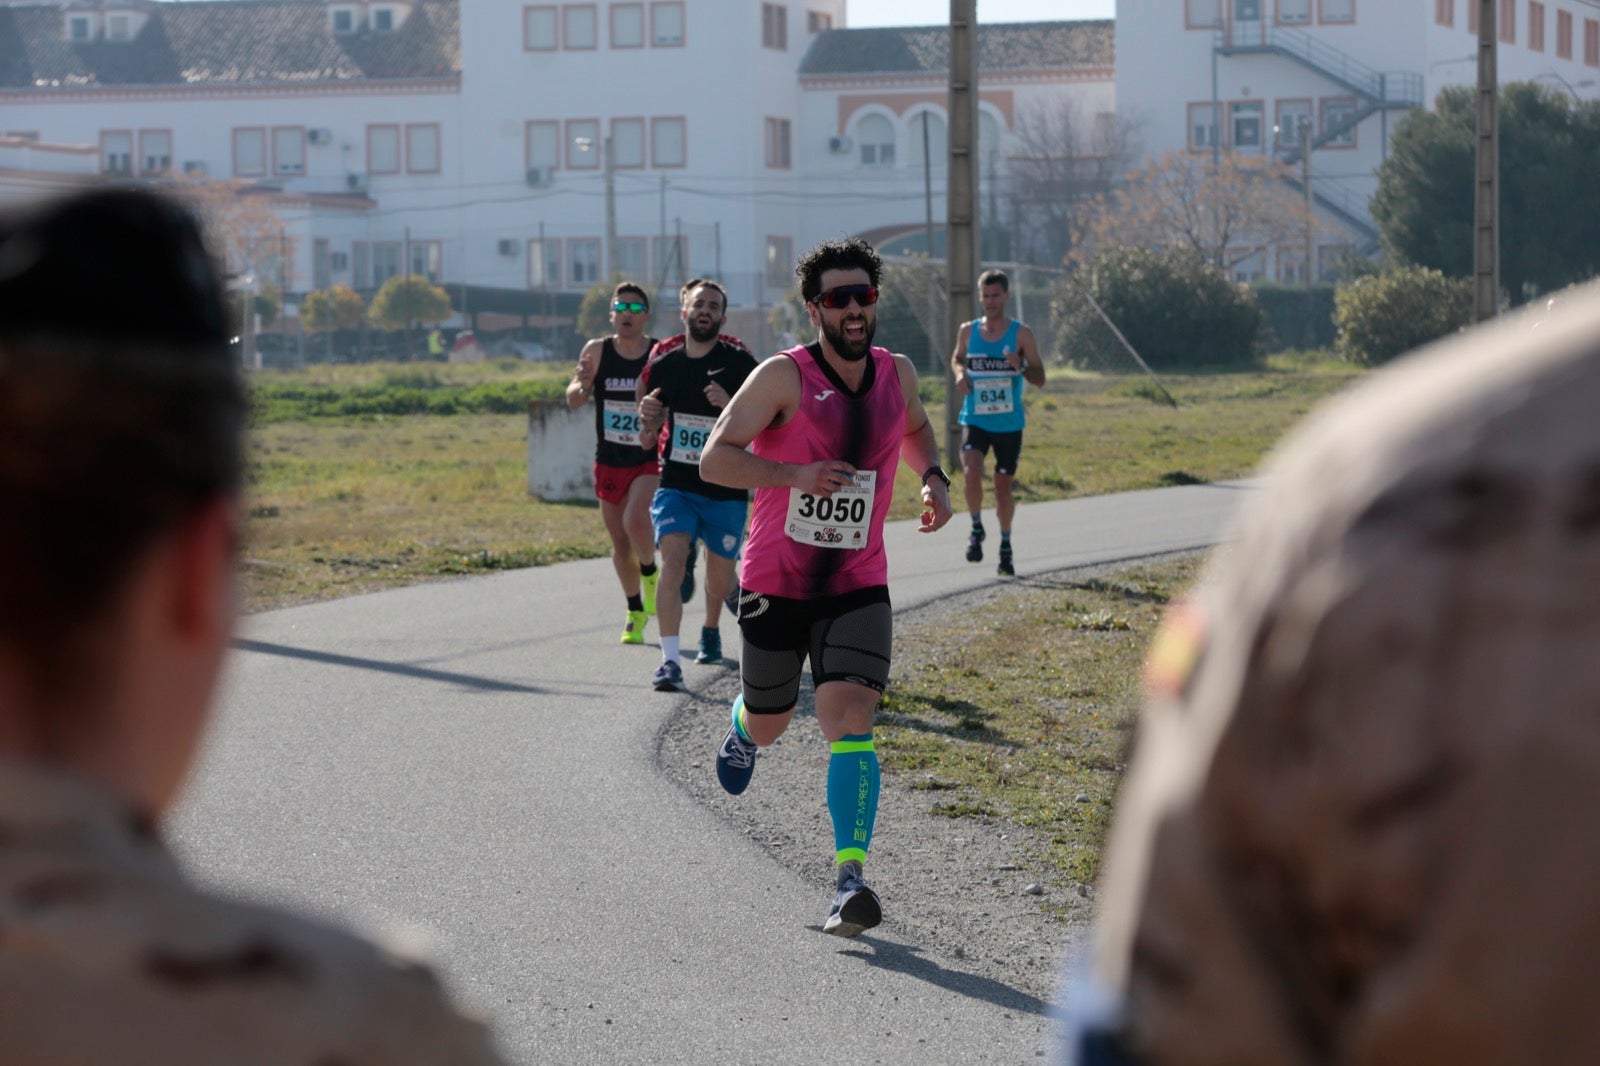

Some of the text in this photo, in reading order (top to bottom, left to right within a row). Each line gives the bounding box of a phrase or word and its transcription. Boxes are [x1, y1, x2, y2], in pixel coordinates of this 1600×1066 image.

[605, 378, 637, 387] GRAN
[981, 389, 1006, 403] 634
[798, 493, 866, 523] 3050
